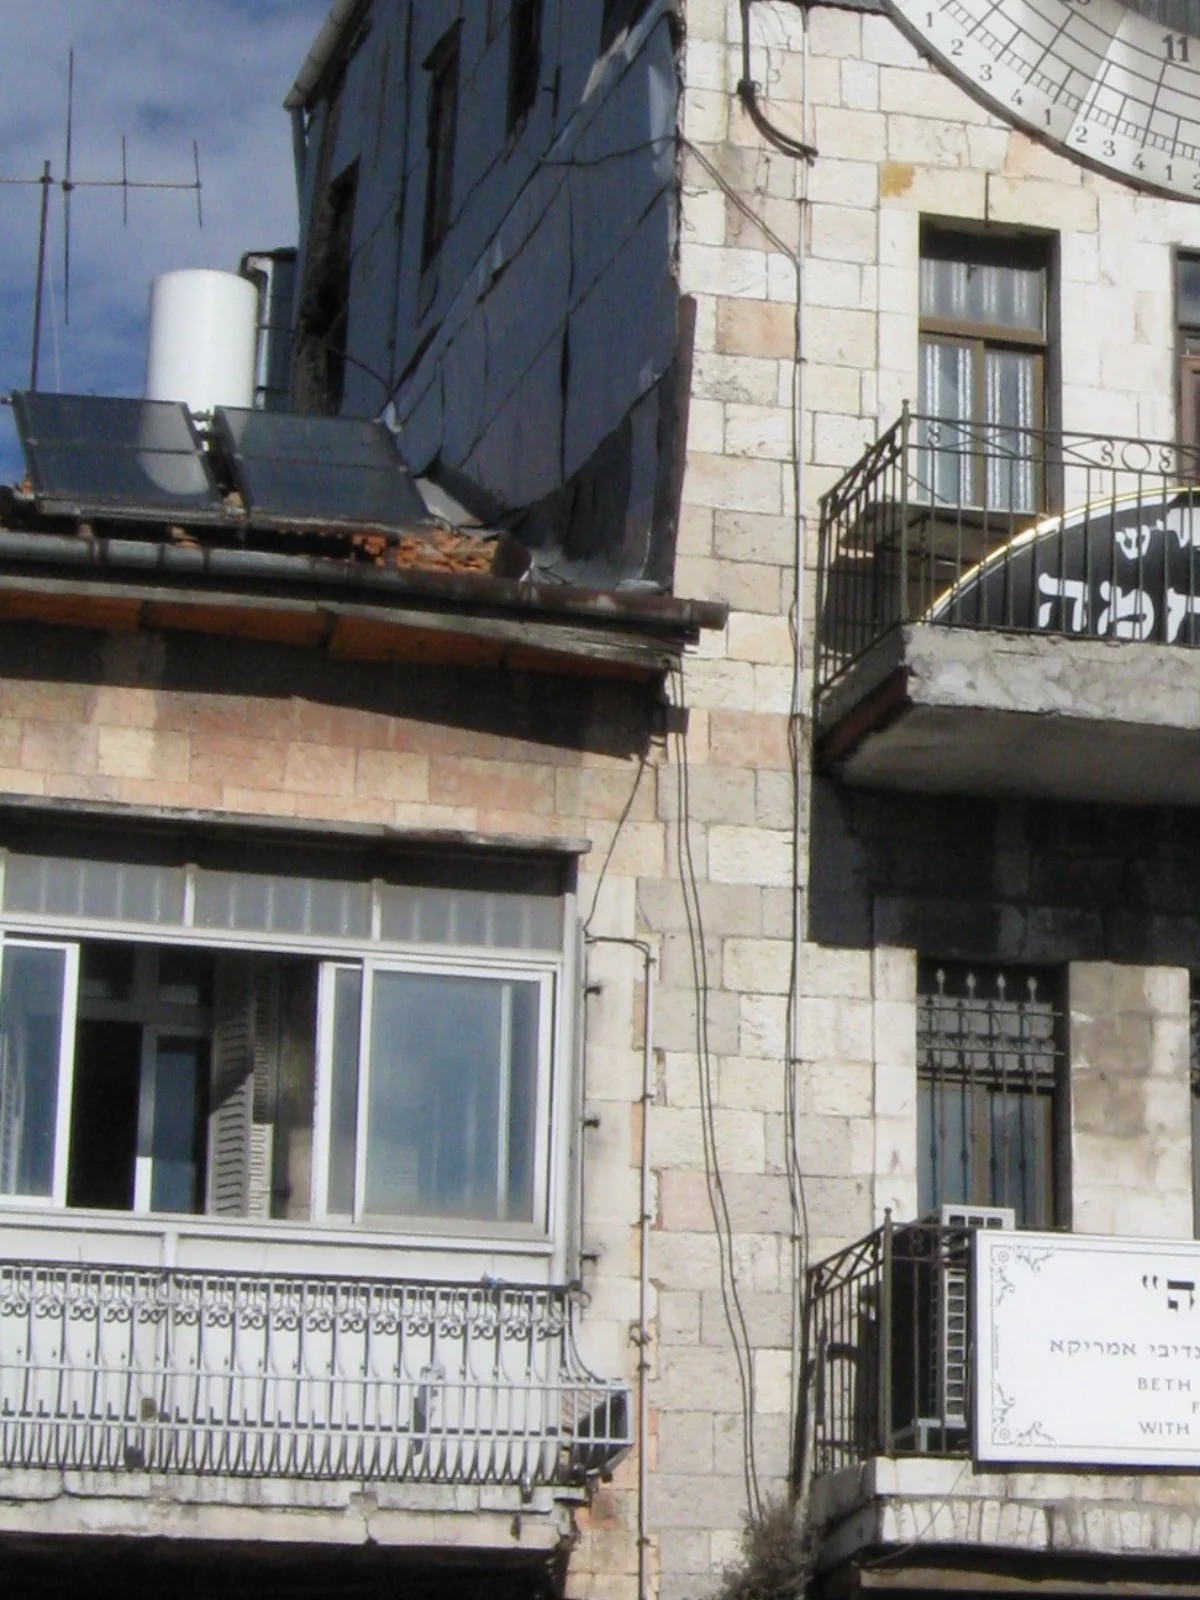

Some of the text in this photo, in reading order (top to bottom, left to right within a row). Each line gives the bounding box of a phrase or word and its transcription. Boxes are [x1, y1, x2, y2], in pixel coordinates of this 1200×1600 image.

[1161, 33, 1190, 63] 11
[926, 11, 933, 28] 1
[951, 38, 964, 56] 2
[979, 63, 993, 81] 3
[1010, 88, 1024, 105] 4
[1044, 107, 1052, 126] 1
[1075, 125, 1088, 143] 2
[1102, 139, 1116, 158] 3
[1132, 152, 1146, 171] 4
[1165, 163, 1173, 182] 1
[1049, 1339, 1137, 1356] אמריקא
[1137, 1377, 1191, 1392] BETH
[1139, 1421, 1190, 1436] WITH
